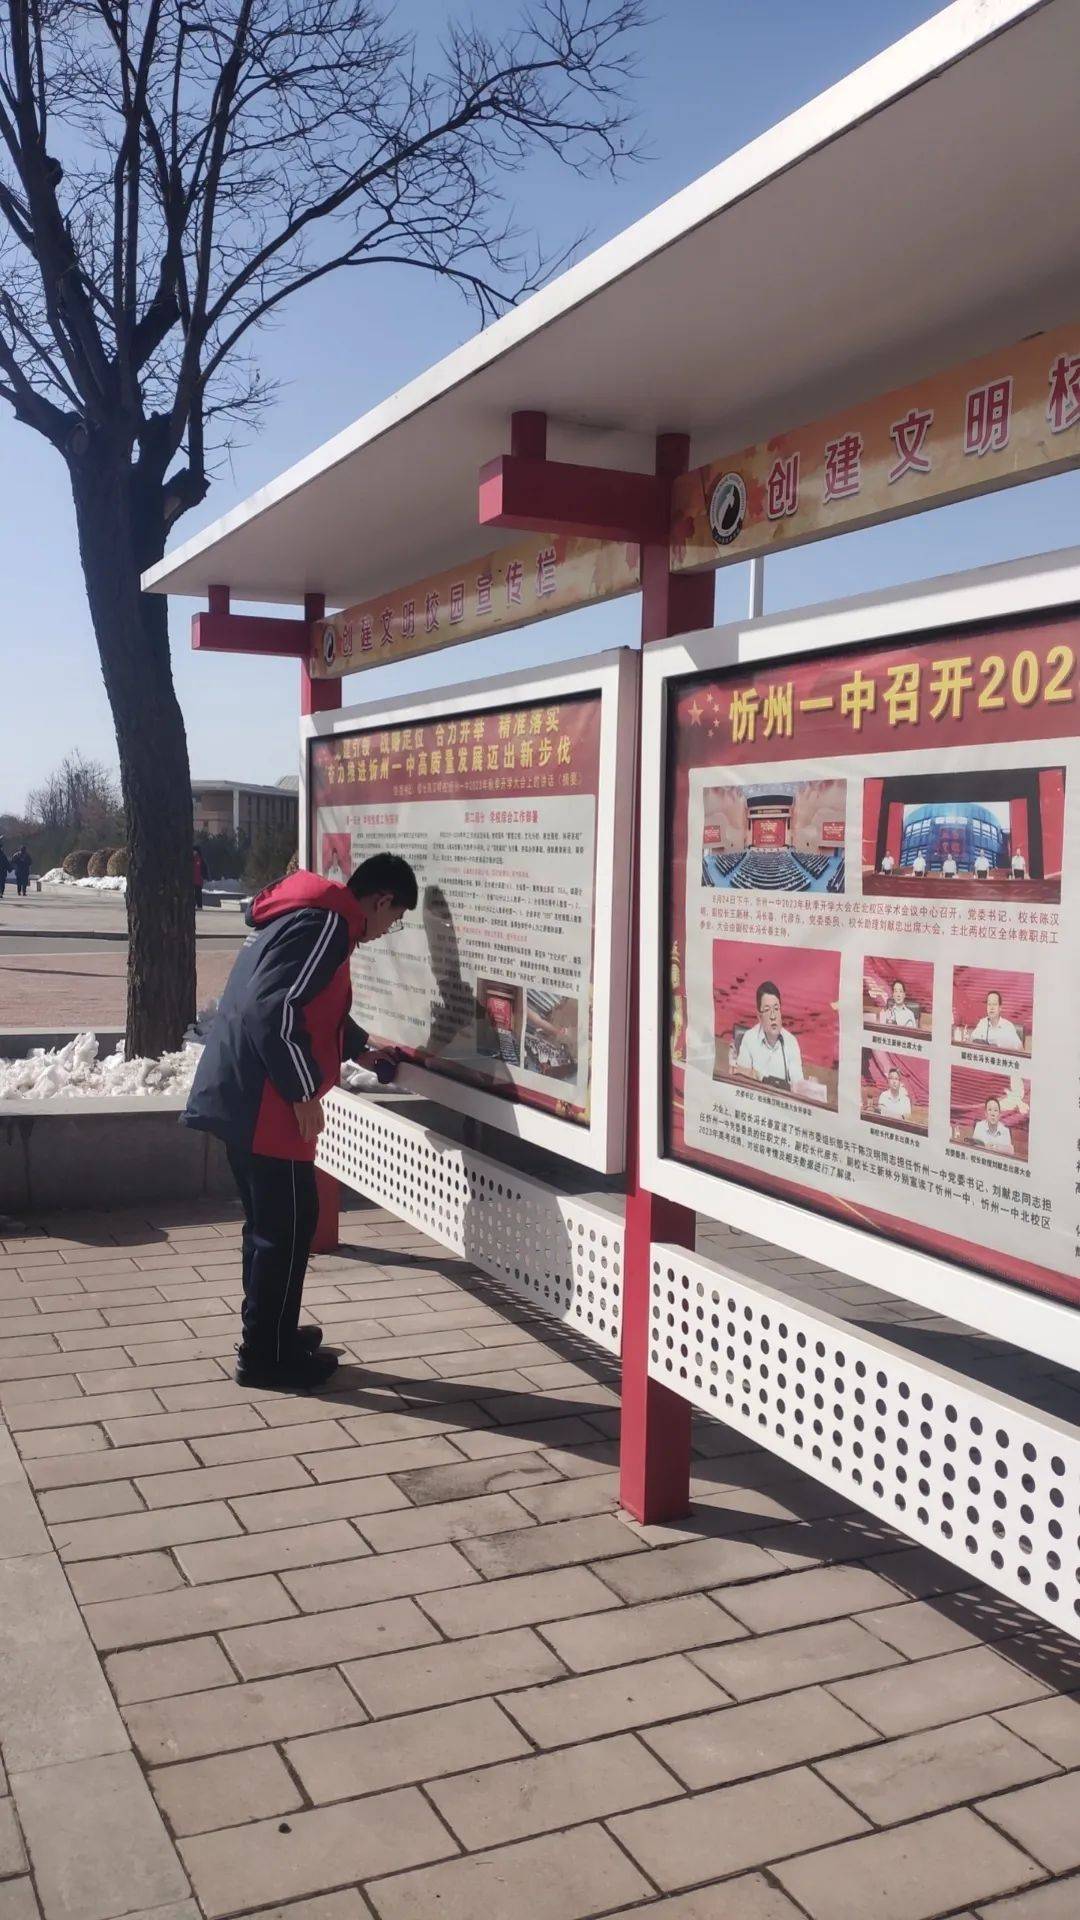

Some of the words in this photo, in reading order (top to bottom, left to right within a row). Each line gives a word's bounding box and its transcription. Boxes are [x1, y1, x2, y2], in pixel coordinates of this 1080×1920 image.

[342, 549, 557, 657] 创建文明校园宣传栏
[499, 706, 560, 739] 精准落实
[729, 646, 1075, 744] 忻州一中召开202
[327, 735, 573, 785] 奋力推进忻州一中高质量发展迈出新步伐
